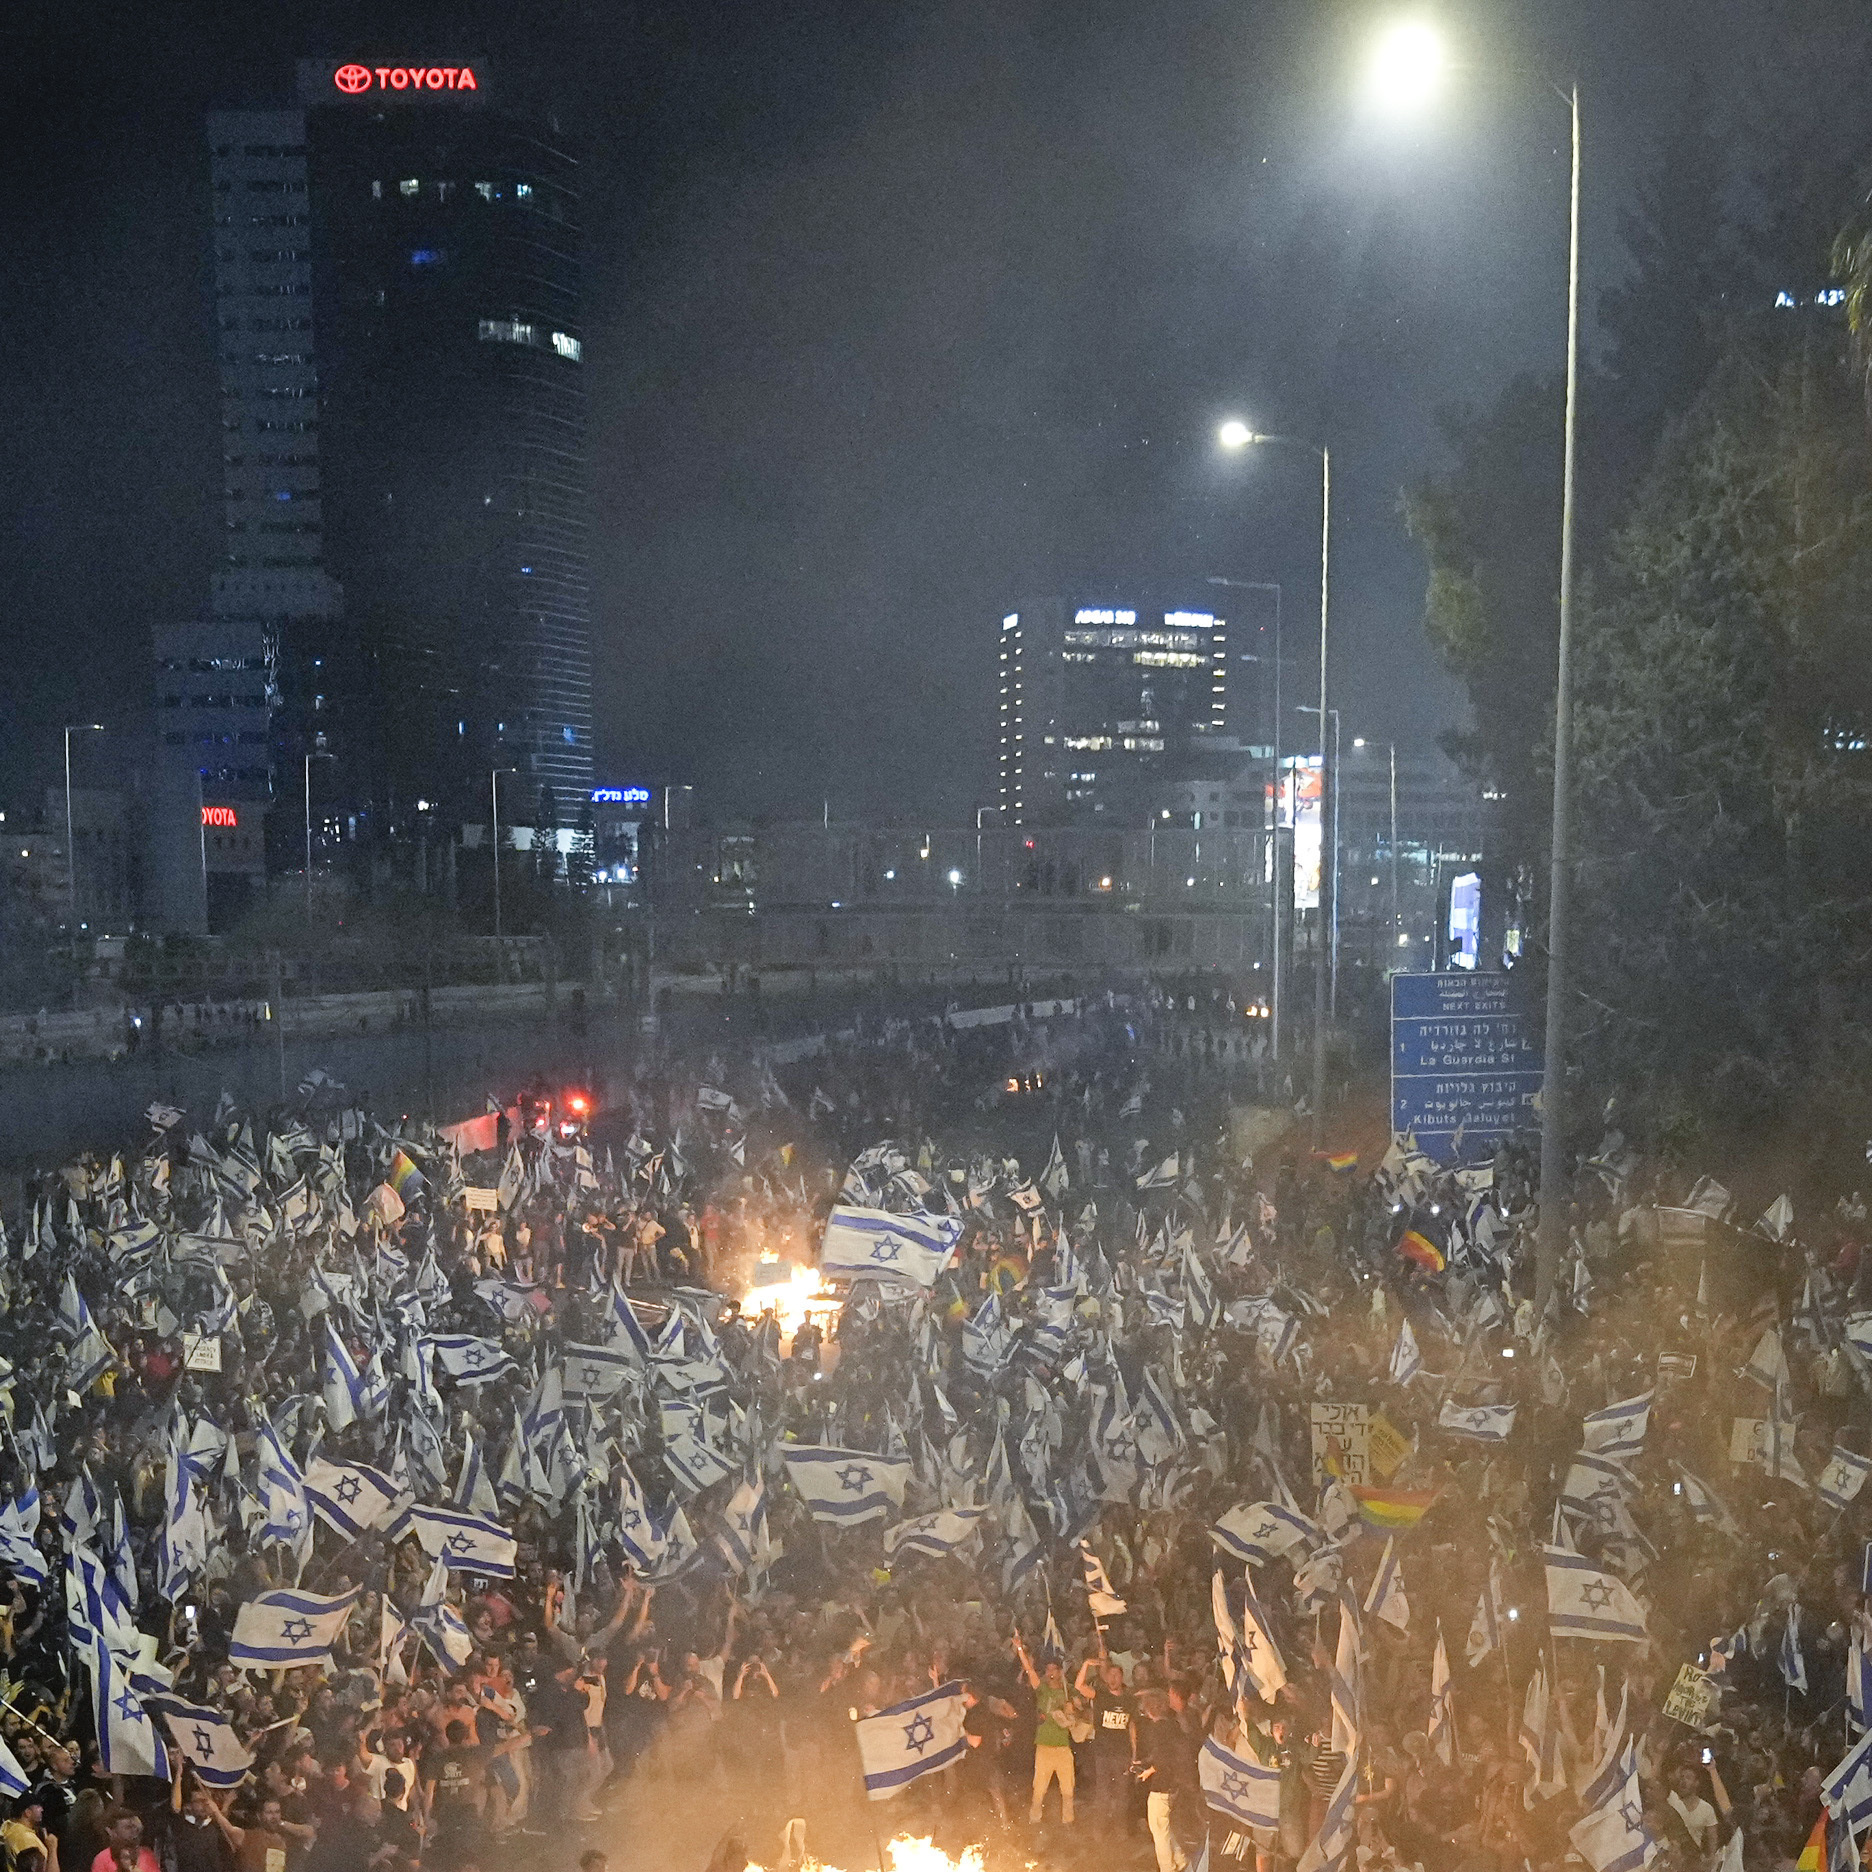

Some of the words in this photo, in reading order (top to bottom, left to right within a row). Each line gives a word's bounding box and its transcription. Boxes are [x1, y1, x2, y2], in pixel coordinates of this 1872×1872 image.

[375, 67, 477, 90] TOYOTA
[201, 806, 237, 826] OYOTA
[1442, 1002, 1469, 1011] NEXT
[1420, 1055, 1436, 1066] La
[1442, 1054, 1495, 1065] Guardia
